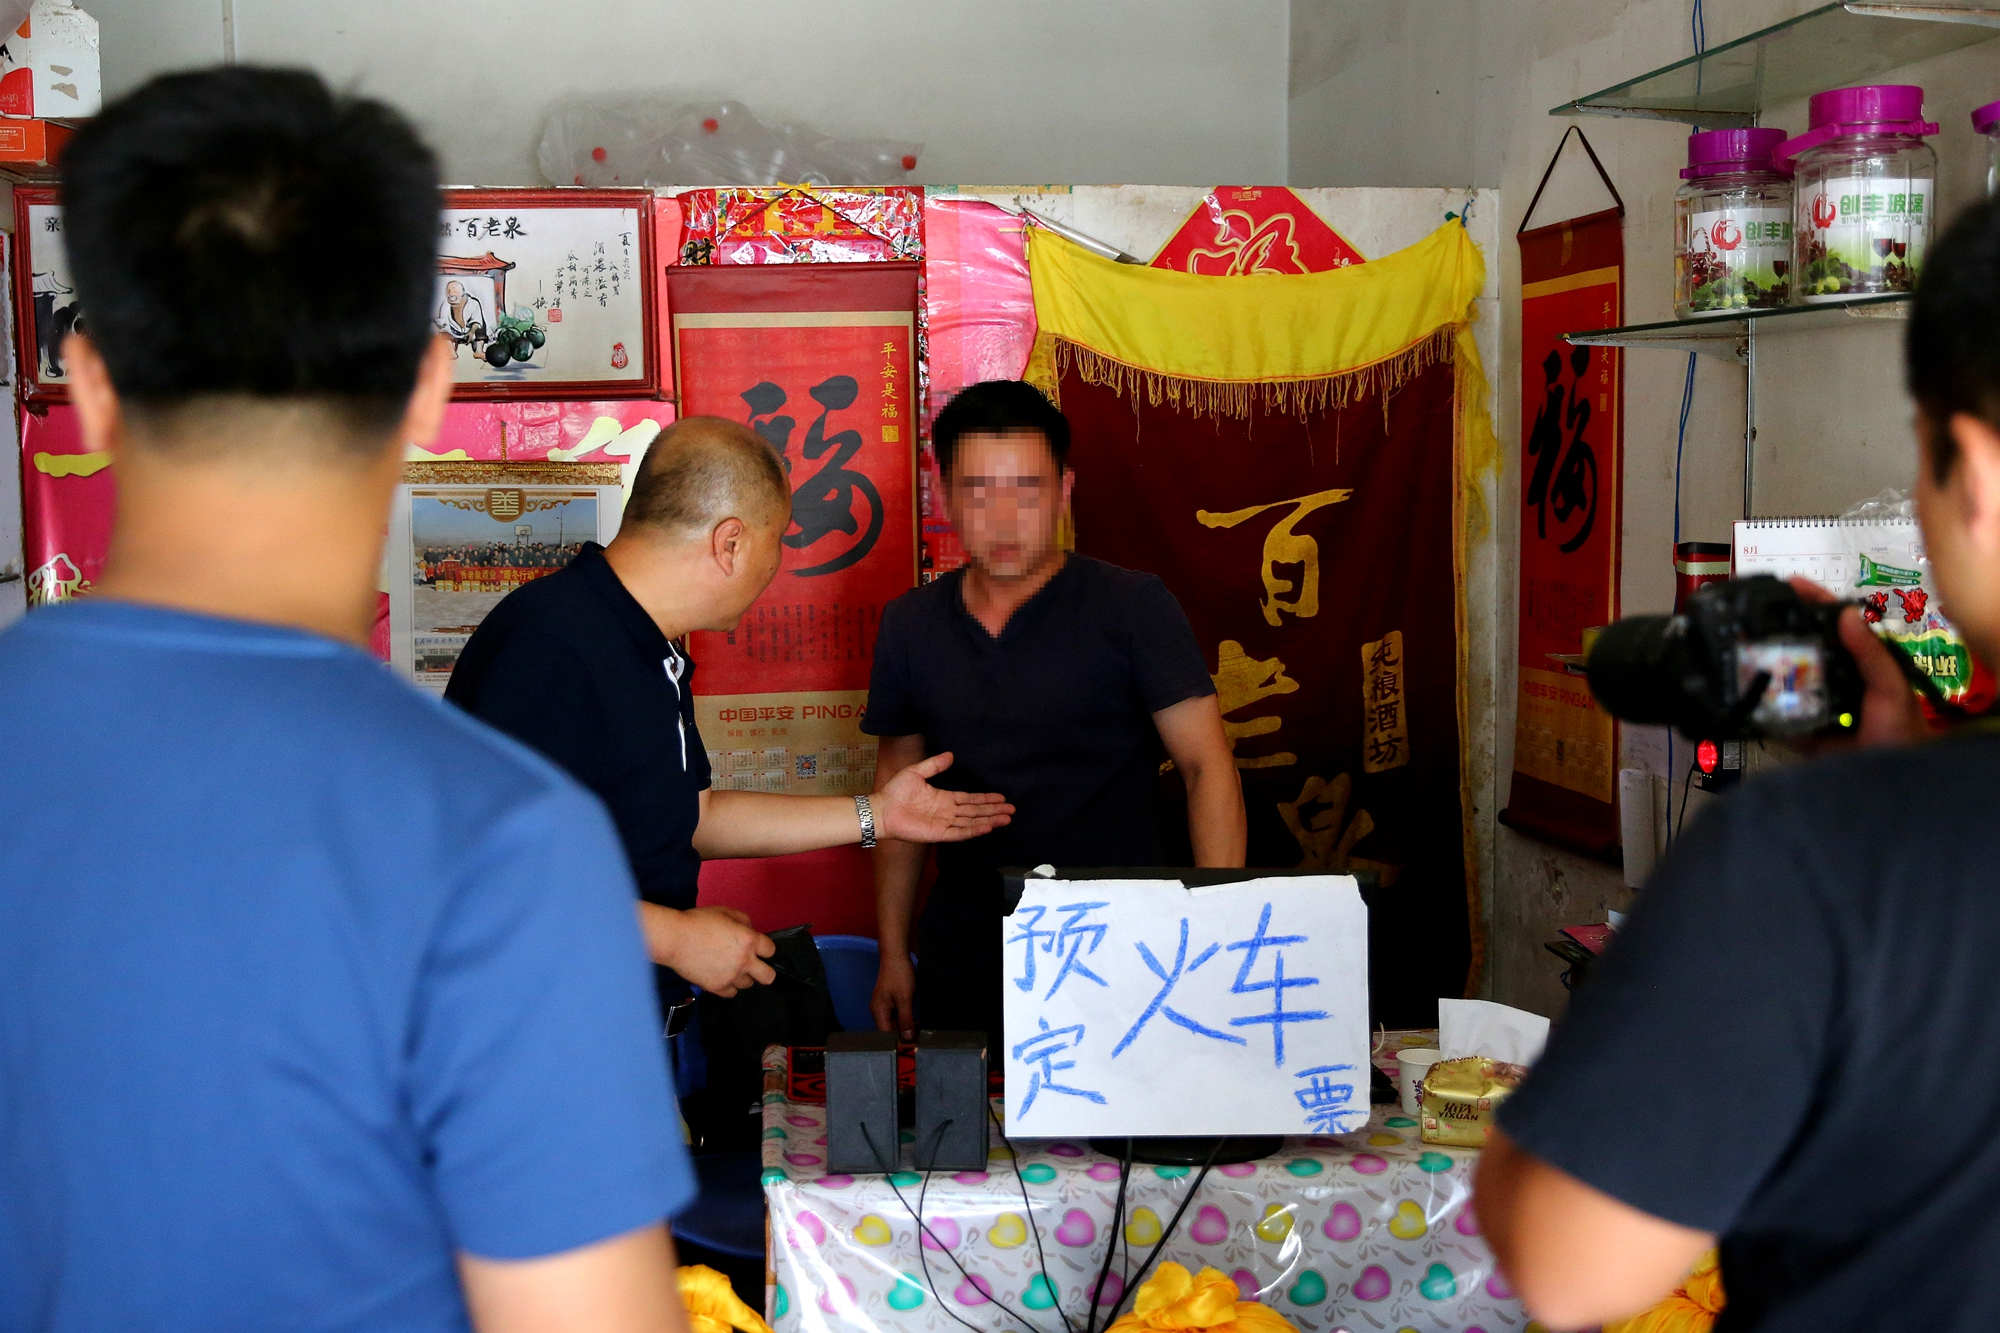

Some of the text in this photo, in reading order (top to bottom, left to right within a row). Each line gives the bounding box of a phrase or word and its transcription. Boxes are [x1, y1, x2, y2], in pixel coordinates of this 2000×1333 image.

[880, 342, 898, 418] 平安是福
[719, 706, 795, 723] 中国平安
[1368, 640, 1402, 766] 纯粮酒坊
[1294, 1063, 1369, 1134] 票
[1439, 1109, 1479, 1121] YIXUAN
